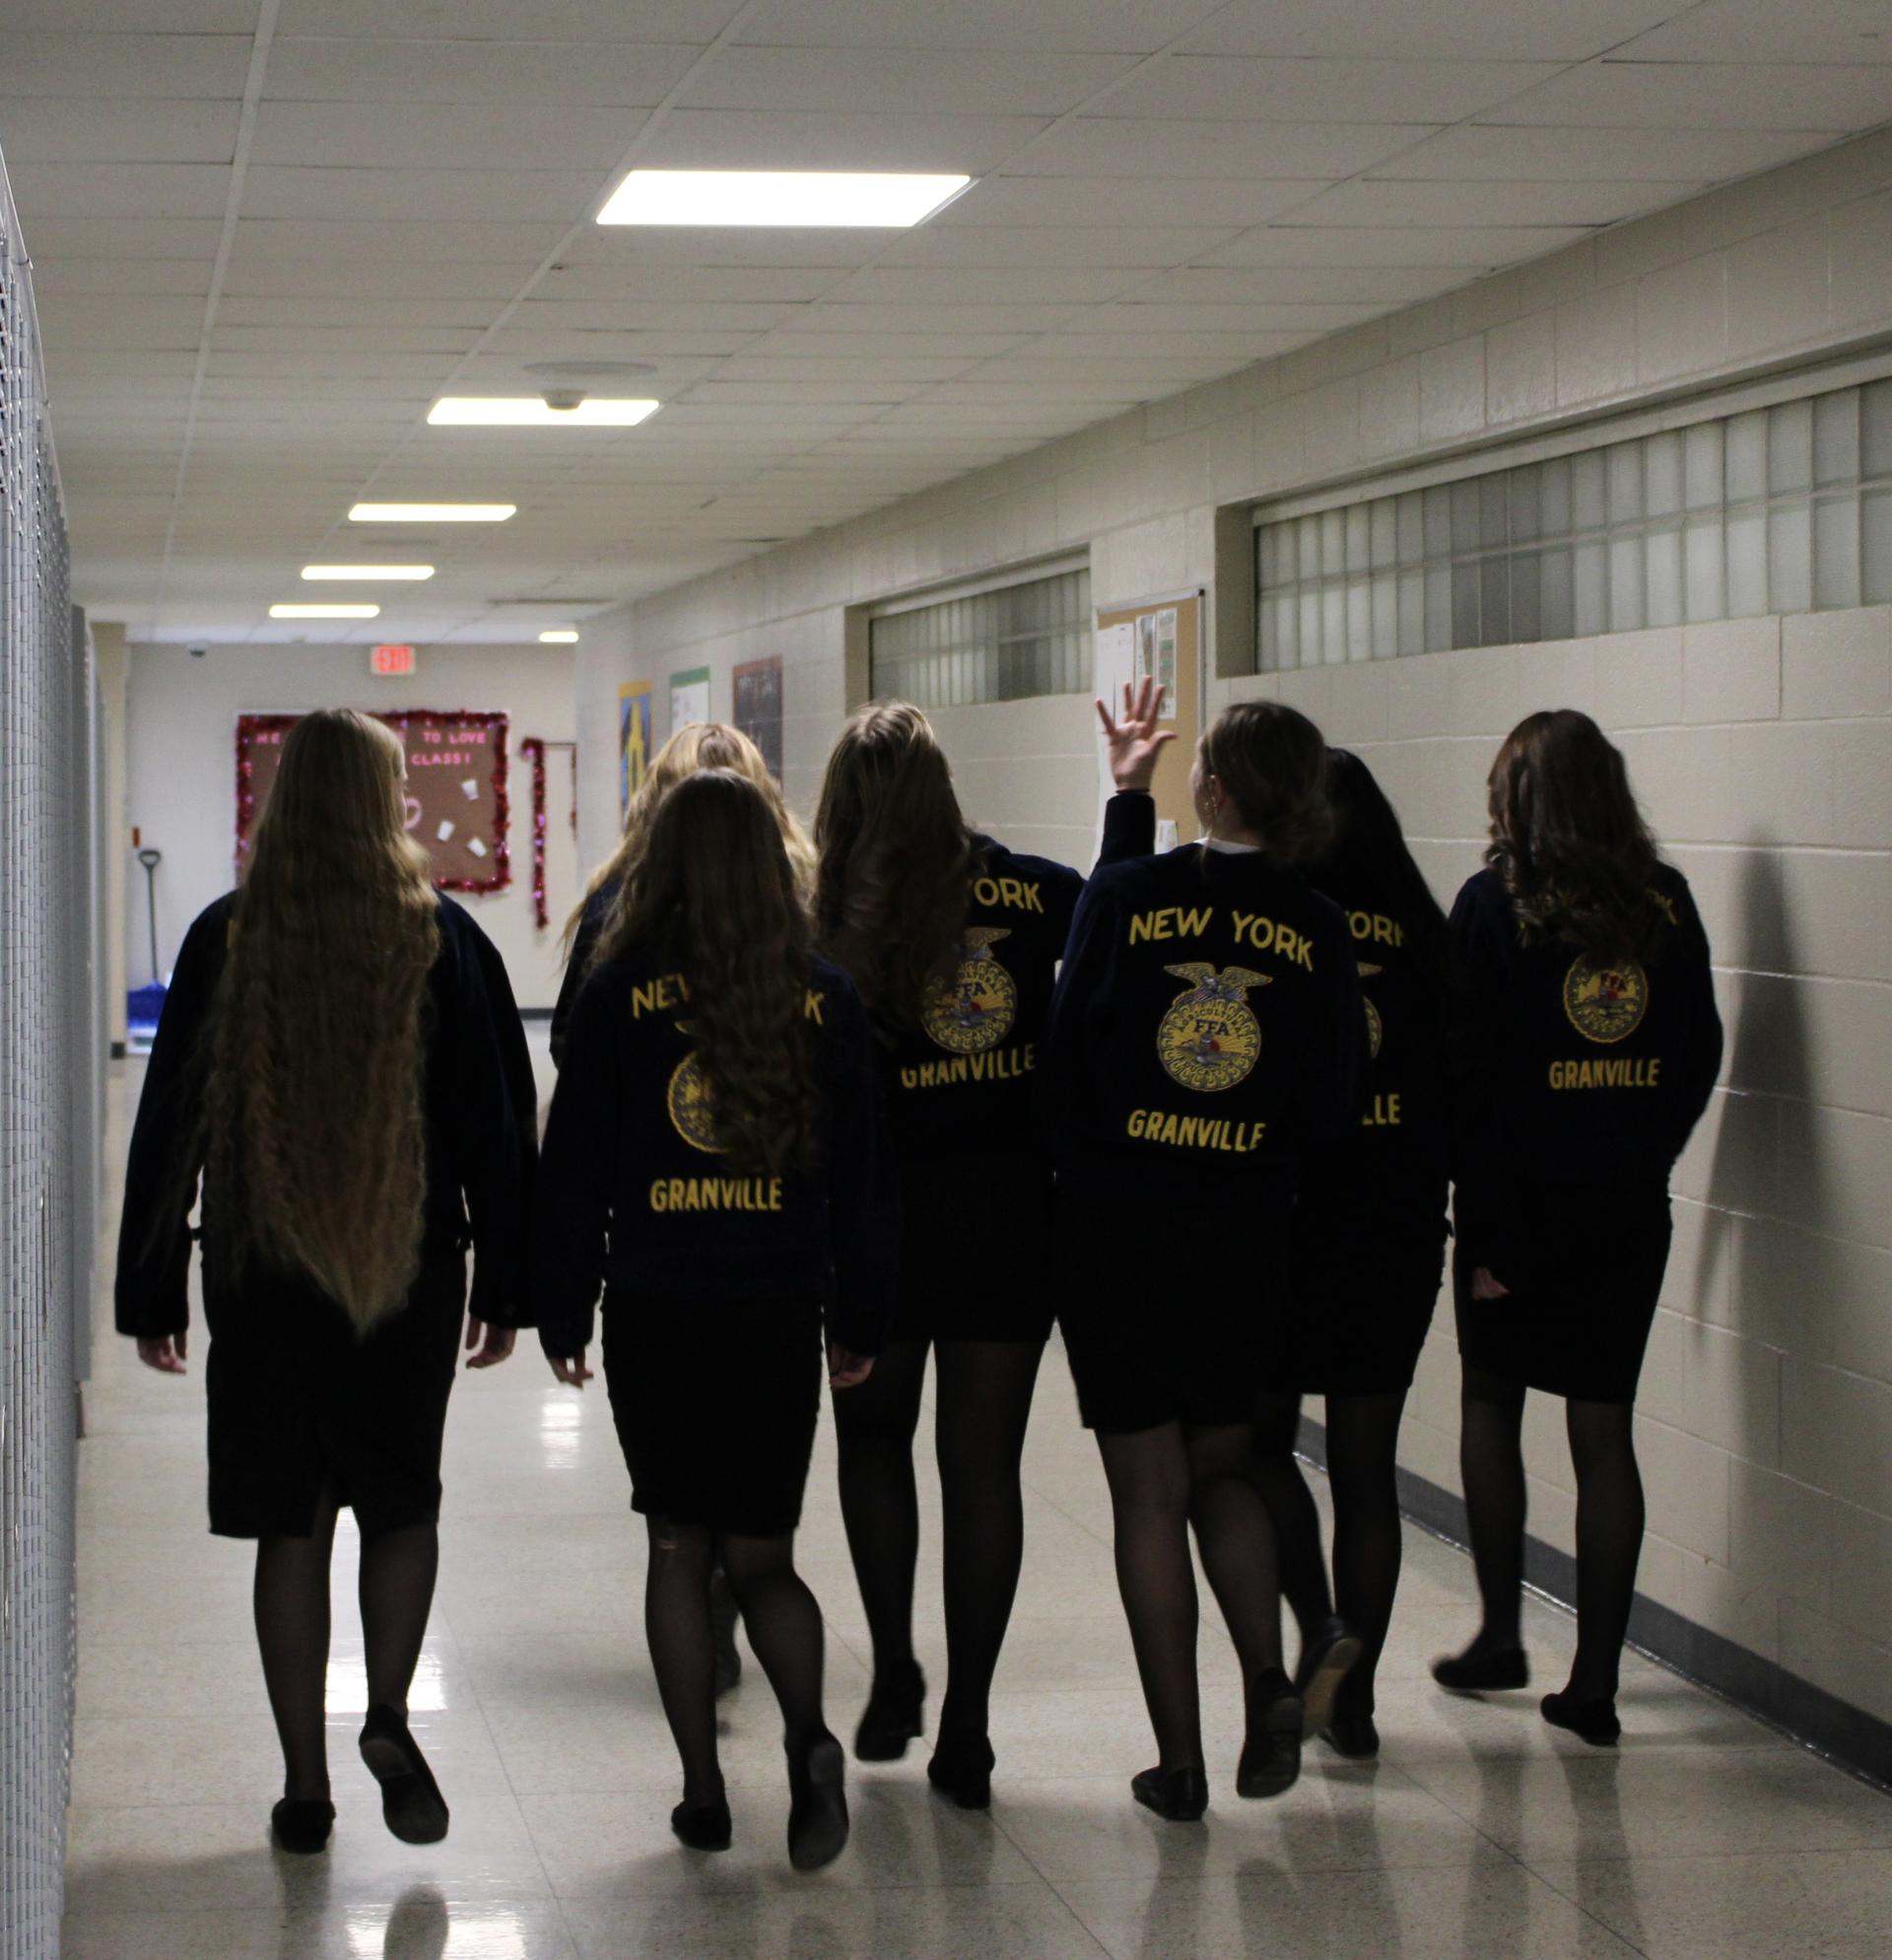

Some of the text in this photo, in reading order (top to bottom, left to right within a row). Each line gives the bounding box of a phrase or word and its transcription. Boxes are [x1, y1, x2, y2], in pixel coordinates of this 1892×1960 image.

[422, 731, 441, 744] TO
[448, 731, 487, 744] LOVE
[974, 877, 1046, 914] ORK
[1128, 906, 1315, 973] NEW YORK
[631, 973, 690, 1020] NE
[1194, 1019, 1230, 1036] FFA
[901, 1043, 1036, 1089] GRANVILLE
[1548, 1058, 1661, 1090] GRANVILLE
[1127, 1110, 1266, 1152] GRANVILLE
[648, 1177, 783, 1213] GRANVILLE
